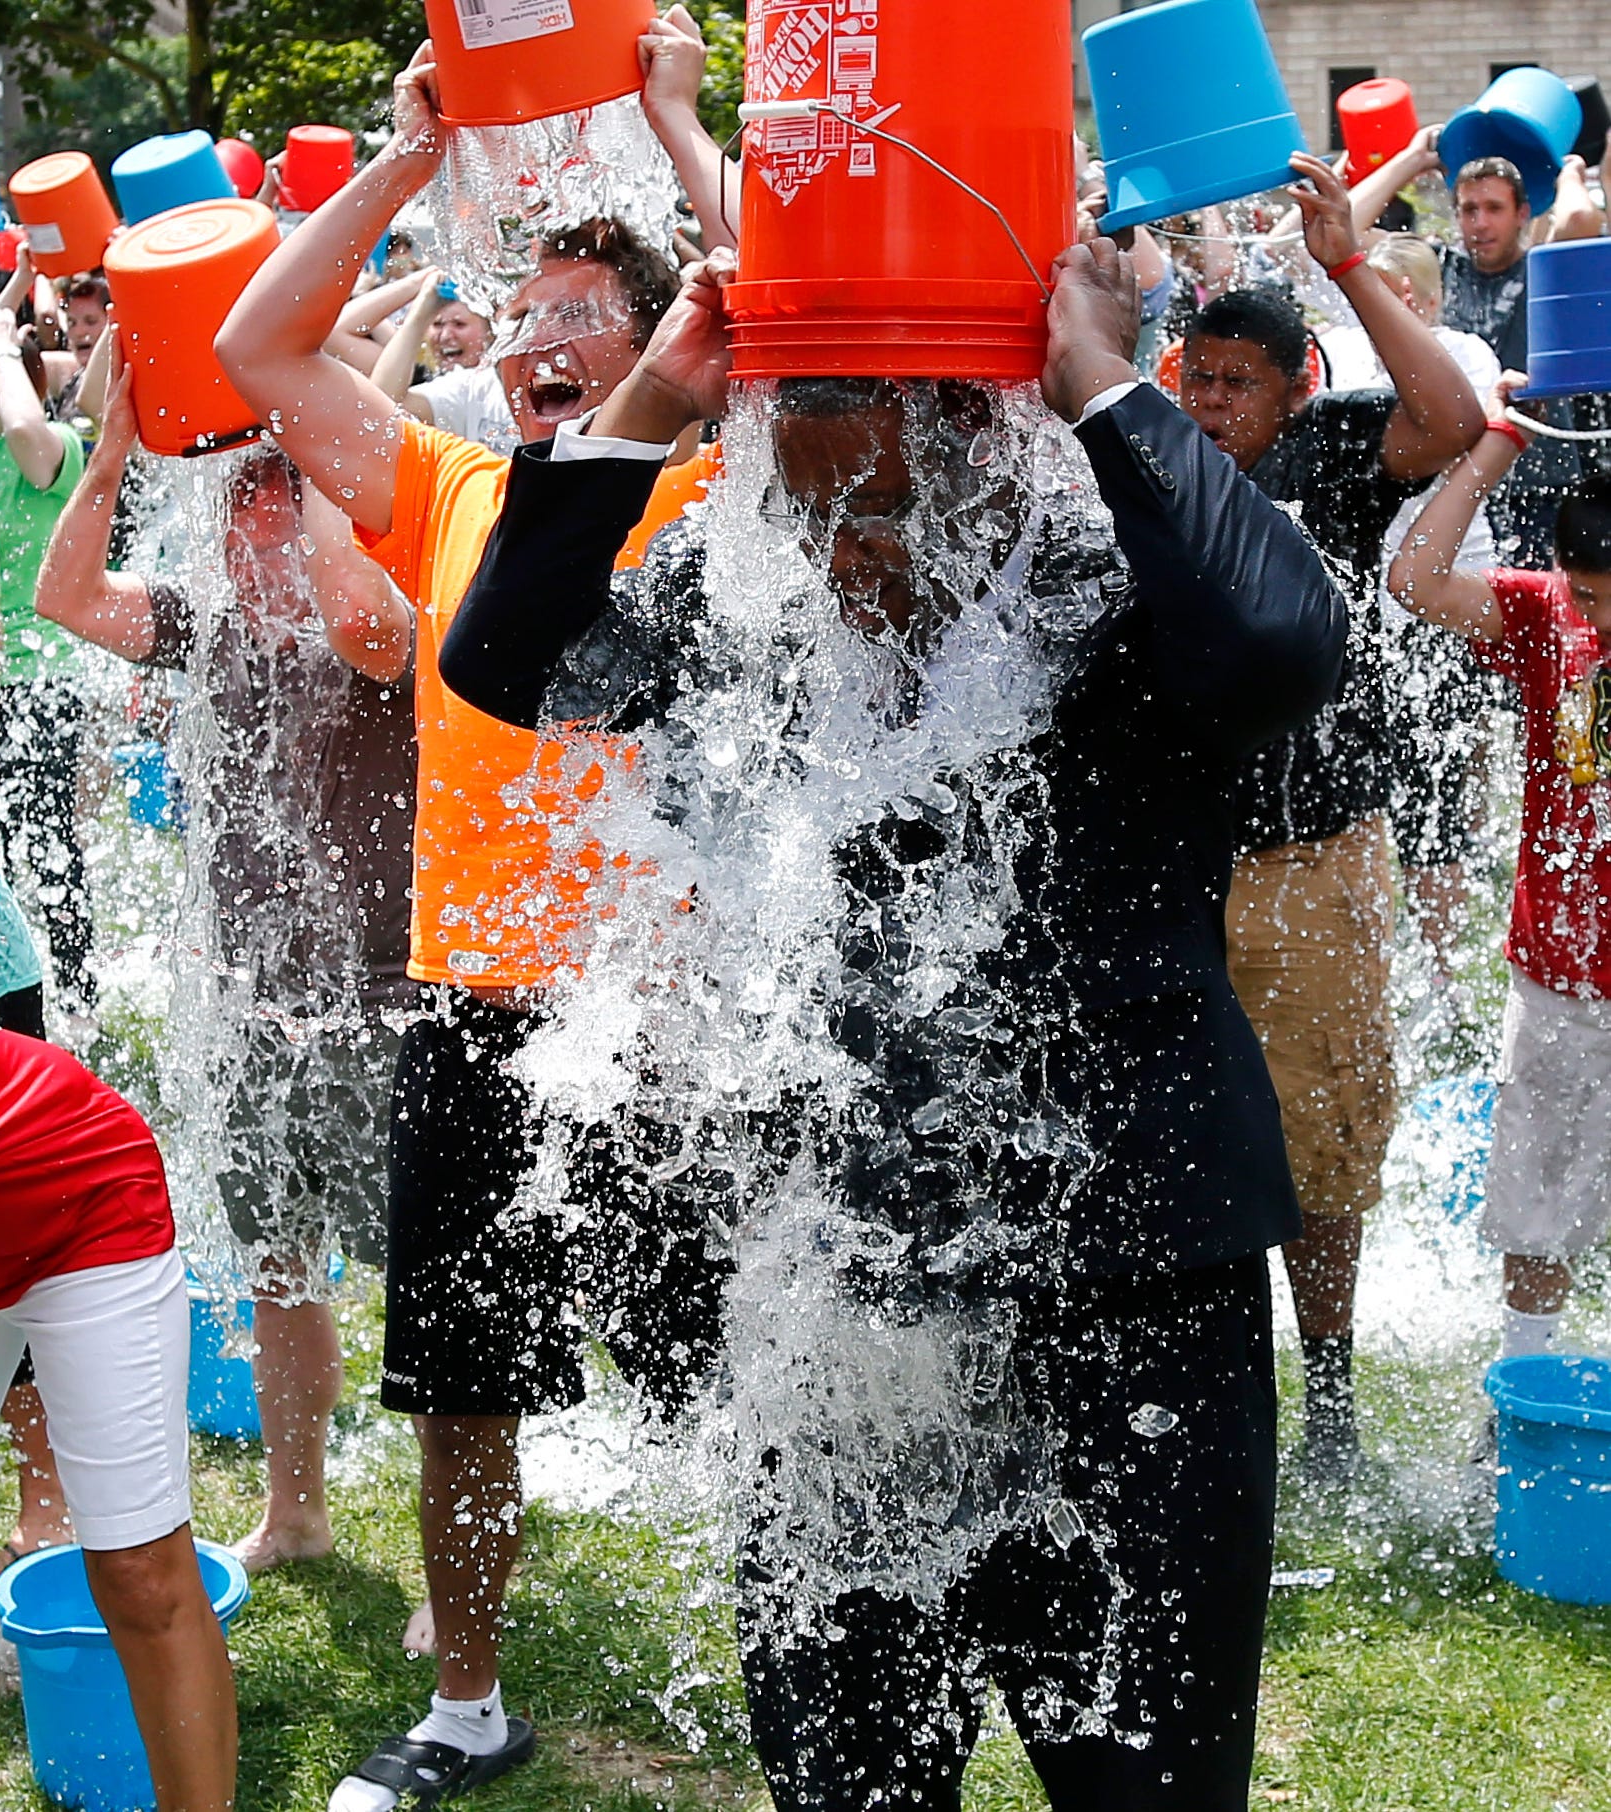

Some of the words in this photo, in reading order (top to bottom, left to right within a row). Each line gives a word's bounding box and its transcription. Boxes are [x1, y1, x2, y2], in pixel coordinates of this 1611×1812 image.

[537, 12, 567, 30] HDX
[763, 11, 800, 72] DEPOT
[788, 54, 821, 94] THE
[381, 1366, 417, 1386] UER
